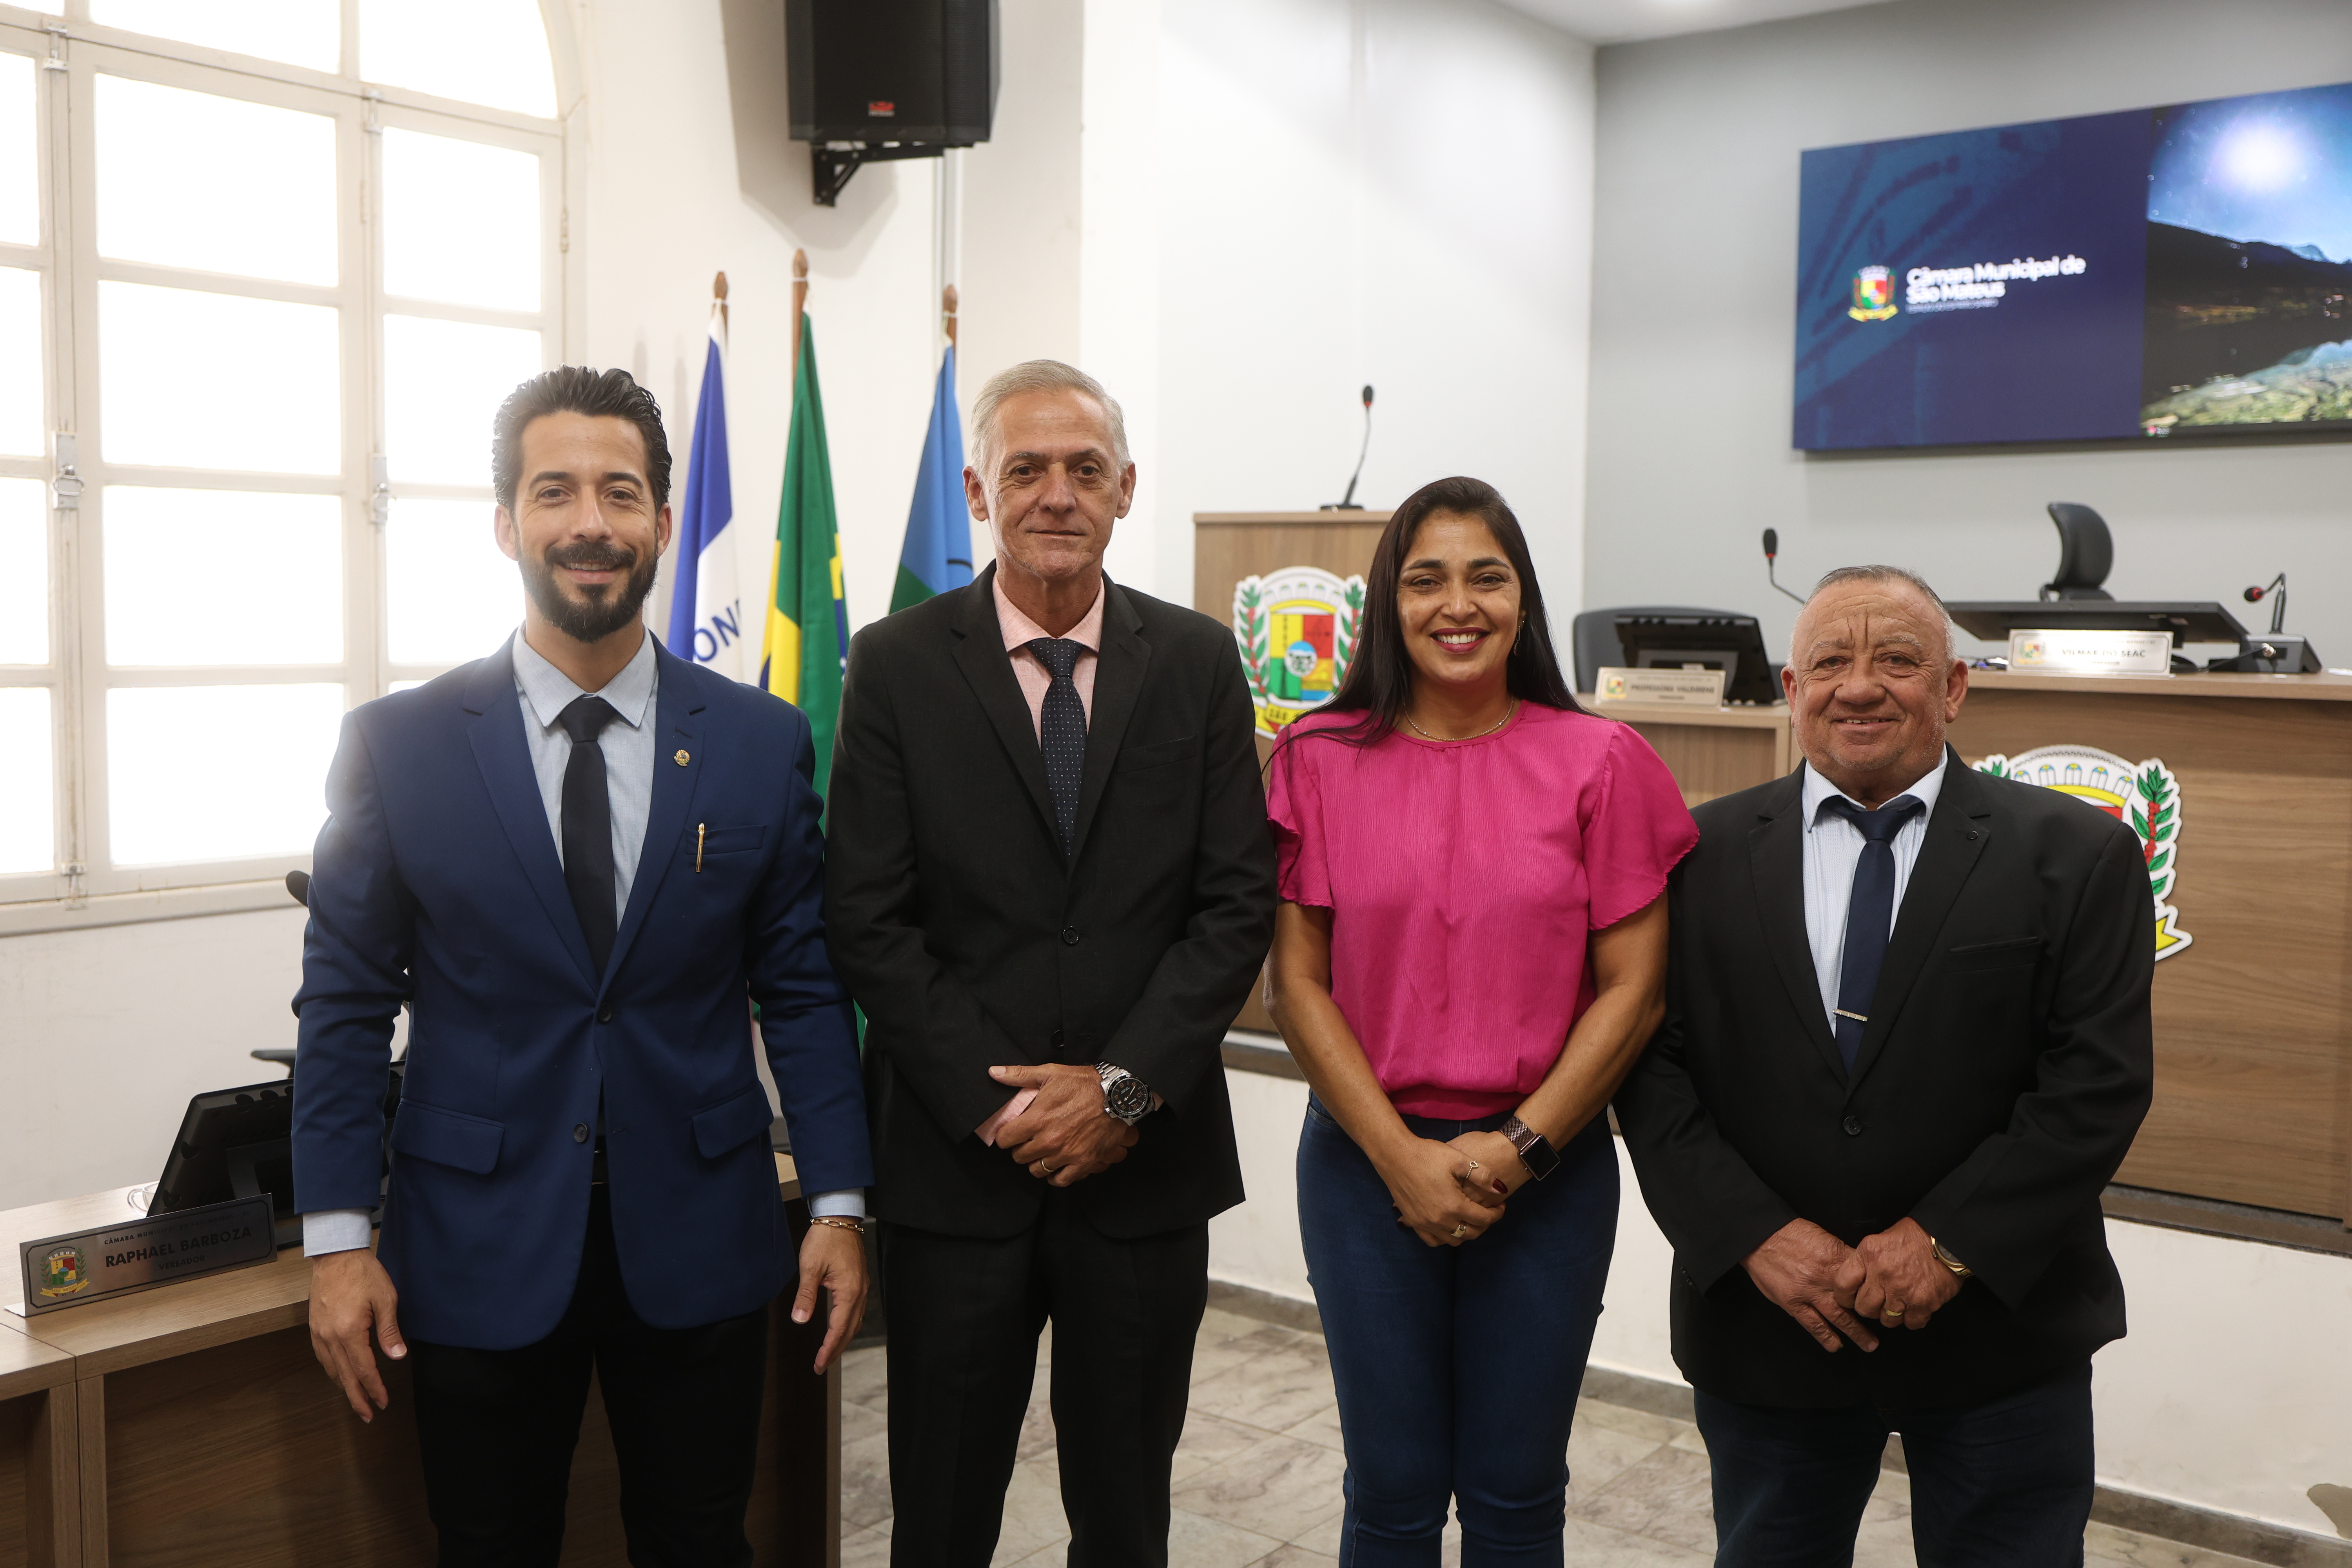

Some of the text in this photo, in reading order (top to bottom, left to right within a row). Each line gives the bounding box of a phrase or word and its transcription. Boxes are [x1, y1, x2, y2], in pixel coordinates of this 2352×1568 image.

[1974, 255, 2060, 281] Municipal
[2060, 254, 2086, 275] de
[1940, 281, 2006, 301] Mateus
[104, 1235, 134, 1245] CÂMARA
[137, 1227, 176, 1238] MUNICIPAL
[208, 1214, 234, 1223] MATEUS
[105, 1227, 252, 1267] RAPHAEL BARBOZA
[159, 1255, 205, 1270] VEREADOR
